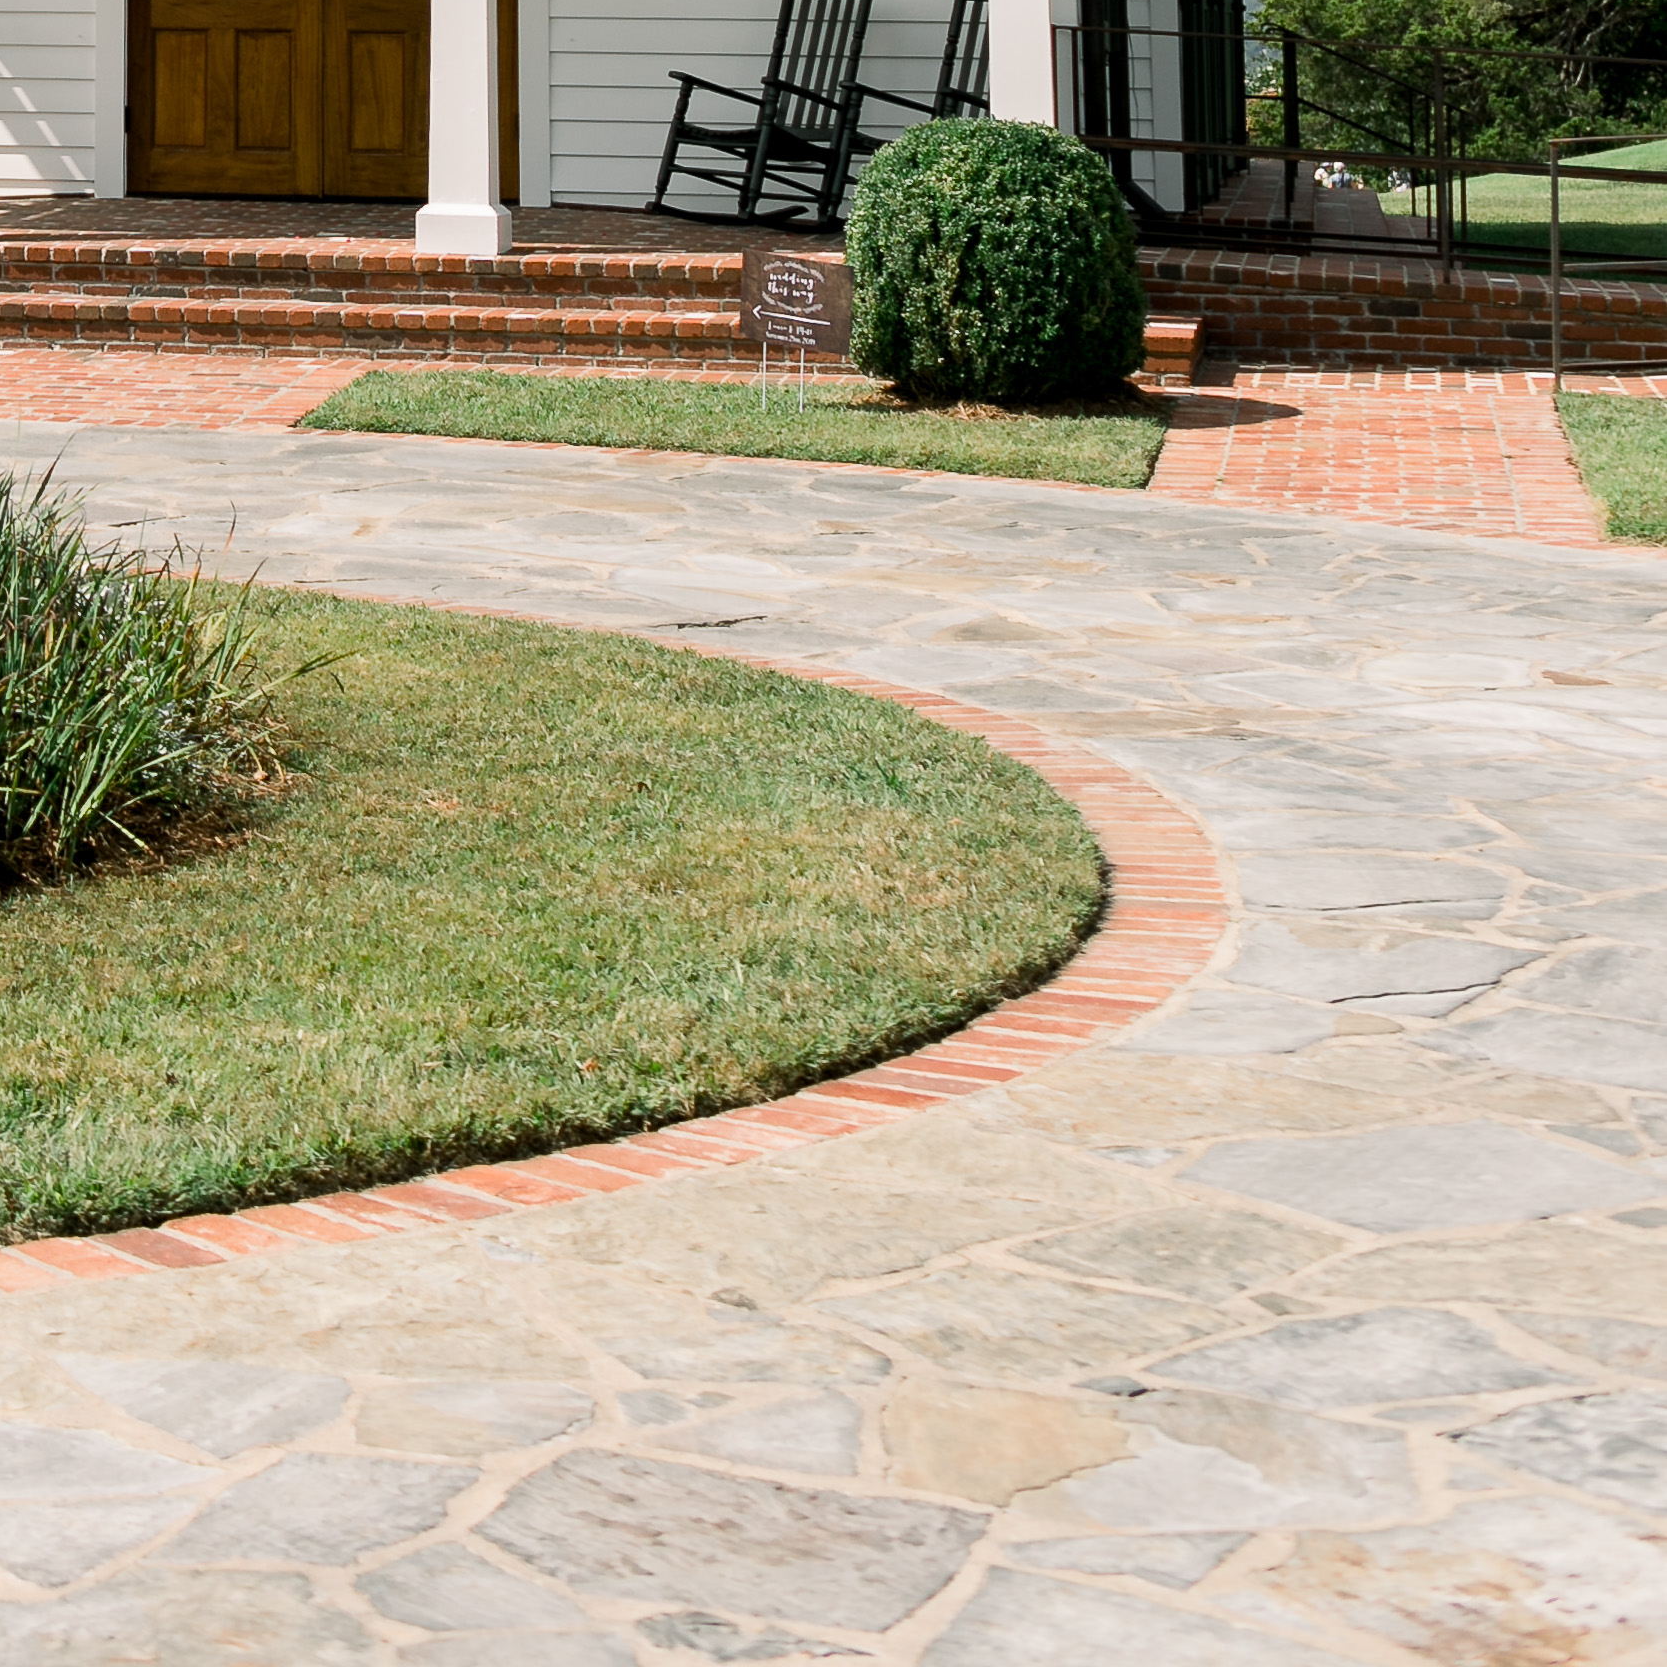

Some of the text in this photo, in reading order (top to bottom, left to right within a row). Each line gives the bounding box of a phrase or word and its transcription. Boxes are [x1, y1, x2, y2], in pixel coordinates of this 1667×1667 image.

[769, 272, 814, 290] wedding
[768, 281, 816, 304] this way
